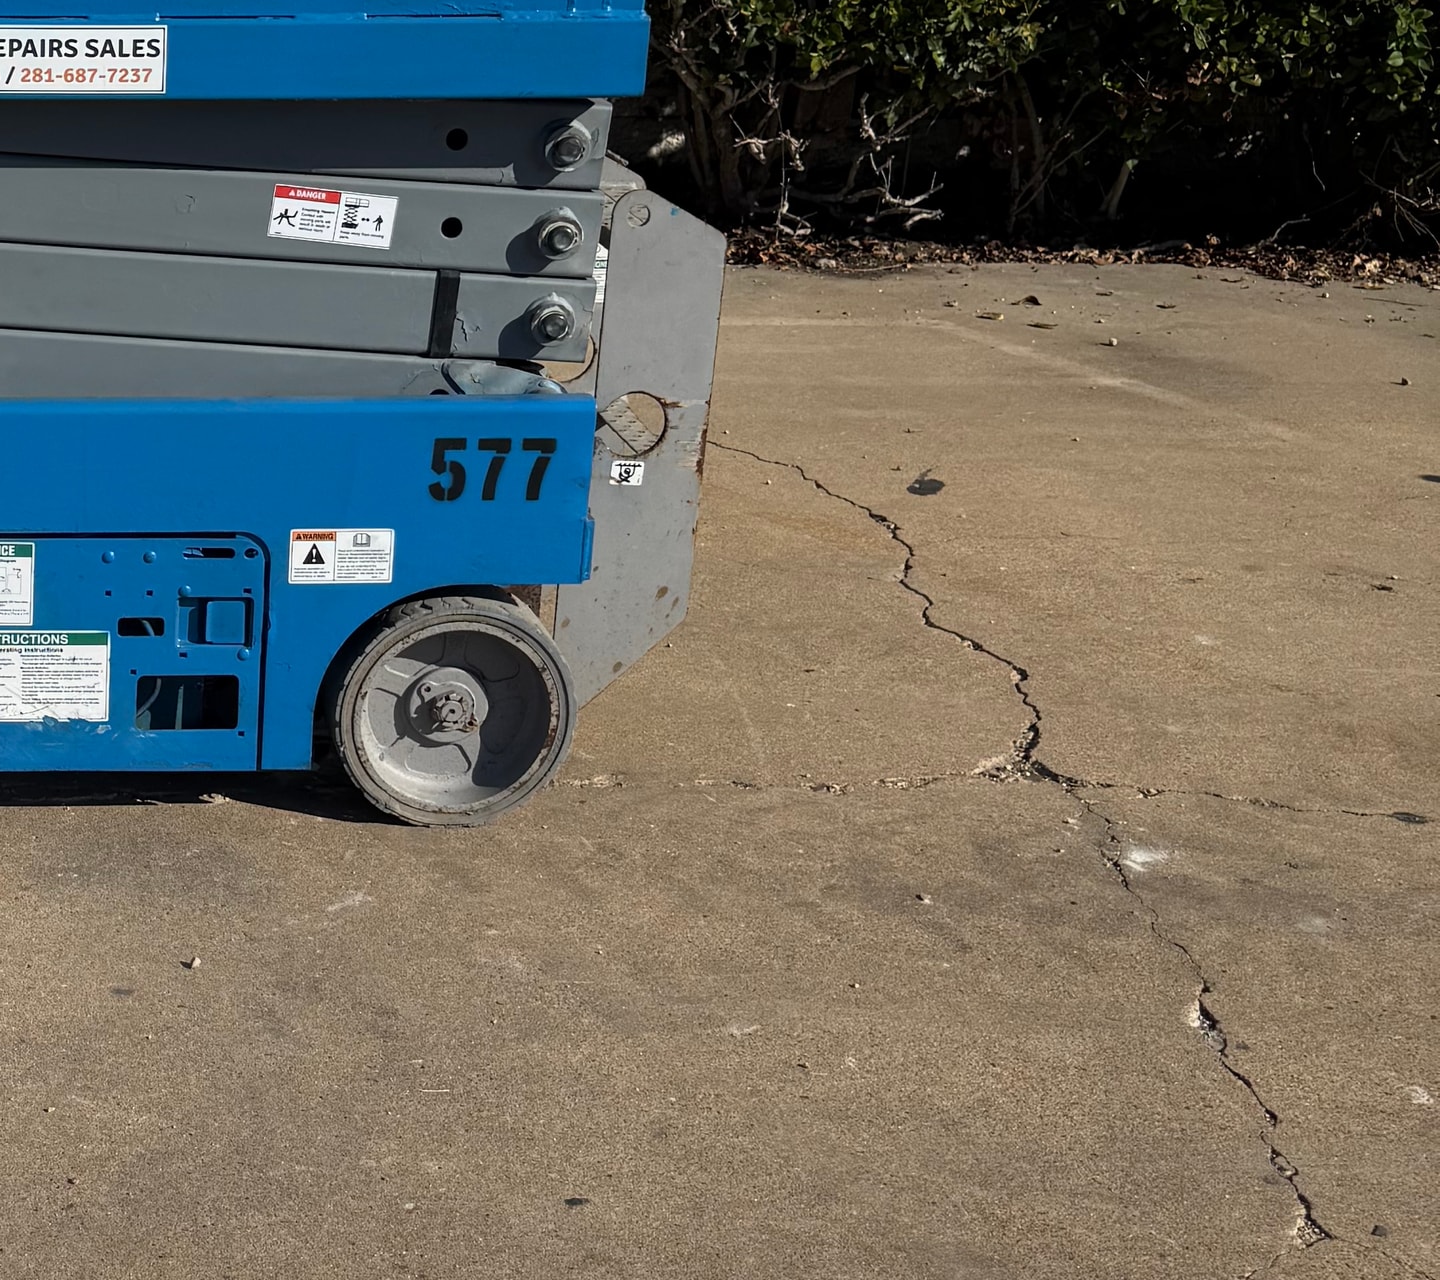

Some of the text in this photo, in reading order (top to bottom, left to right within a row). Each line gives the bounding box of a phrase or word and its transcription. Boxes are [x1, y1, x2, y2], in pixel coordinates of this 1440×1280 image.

[84, 38, 160, 58] SALES
[20, 68, 152, 83] 281-687-7237
[296, 190, 326, 201] DANGER
[428, 437, 557, 501] 577
